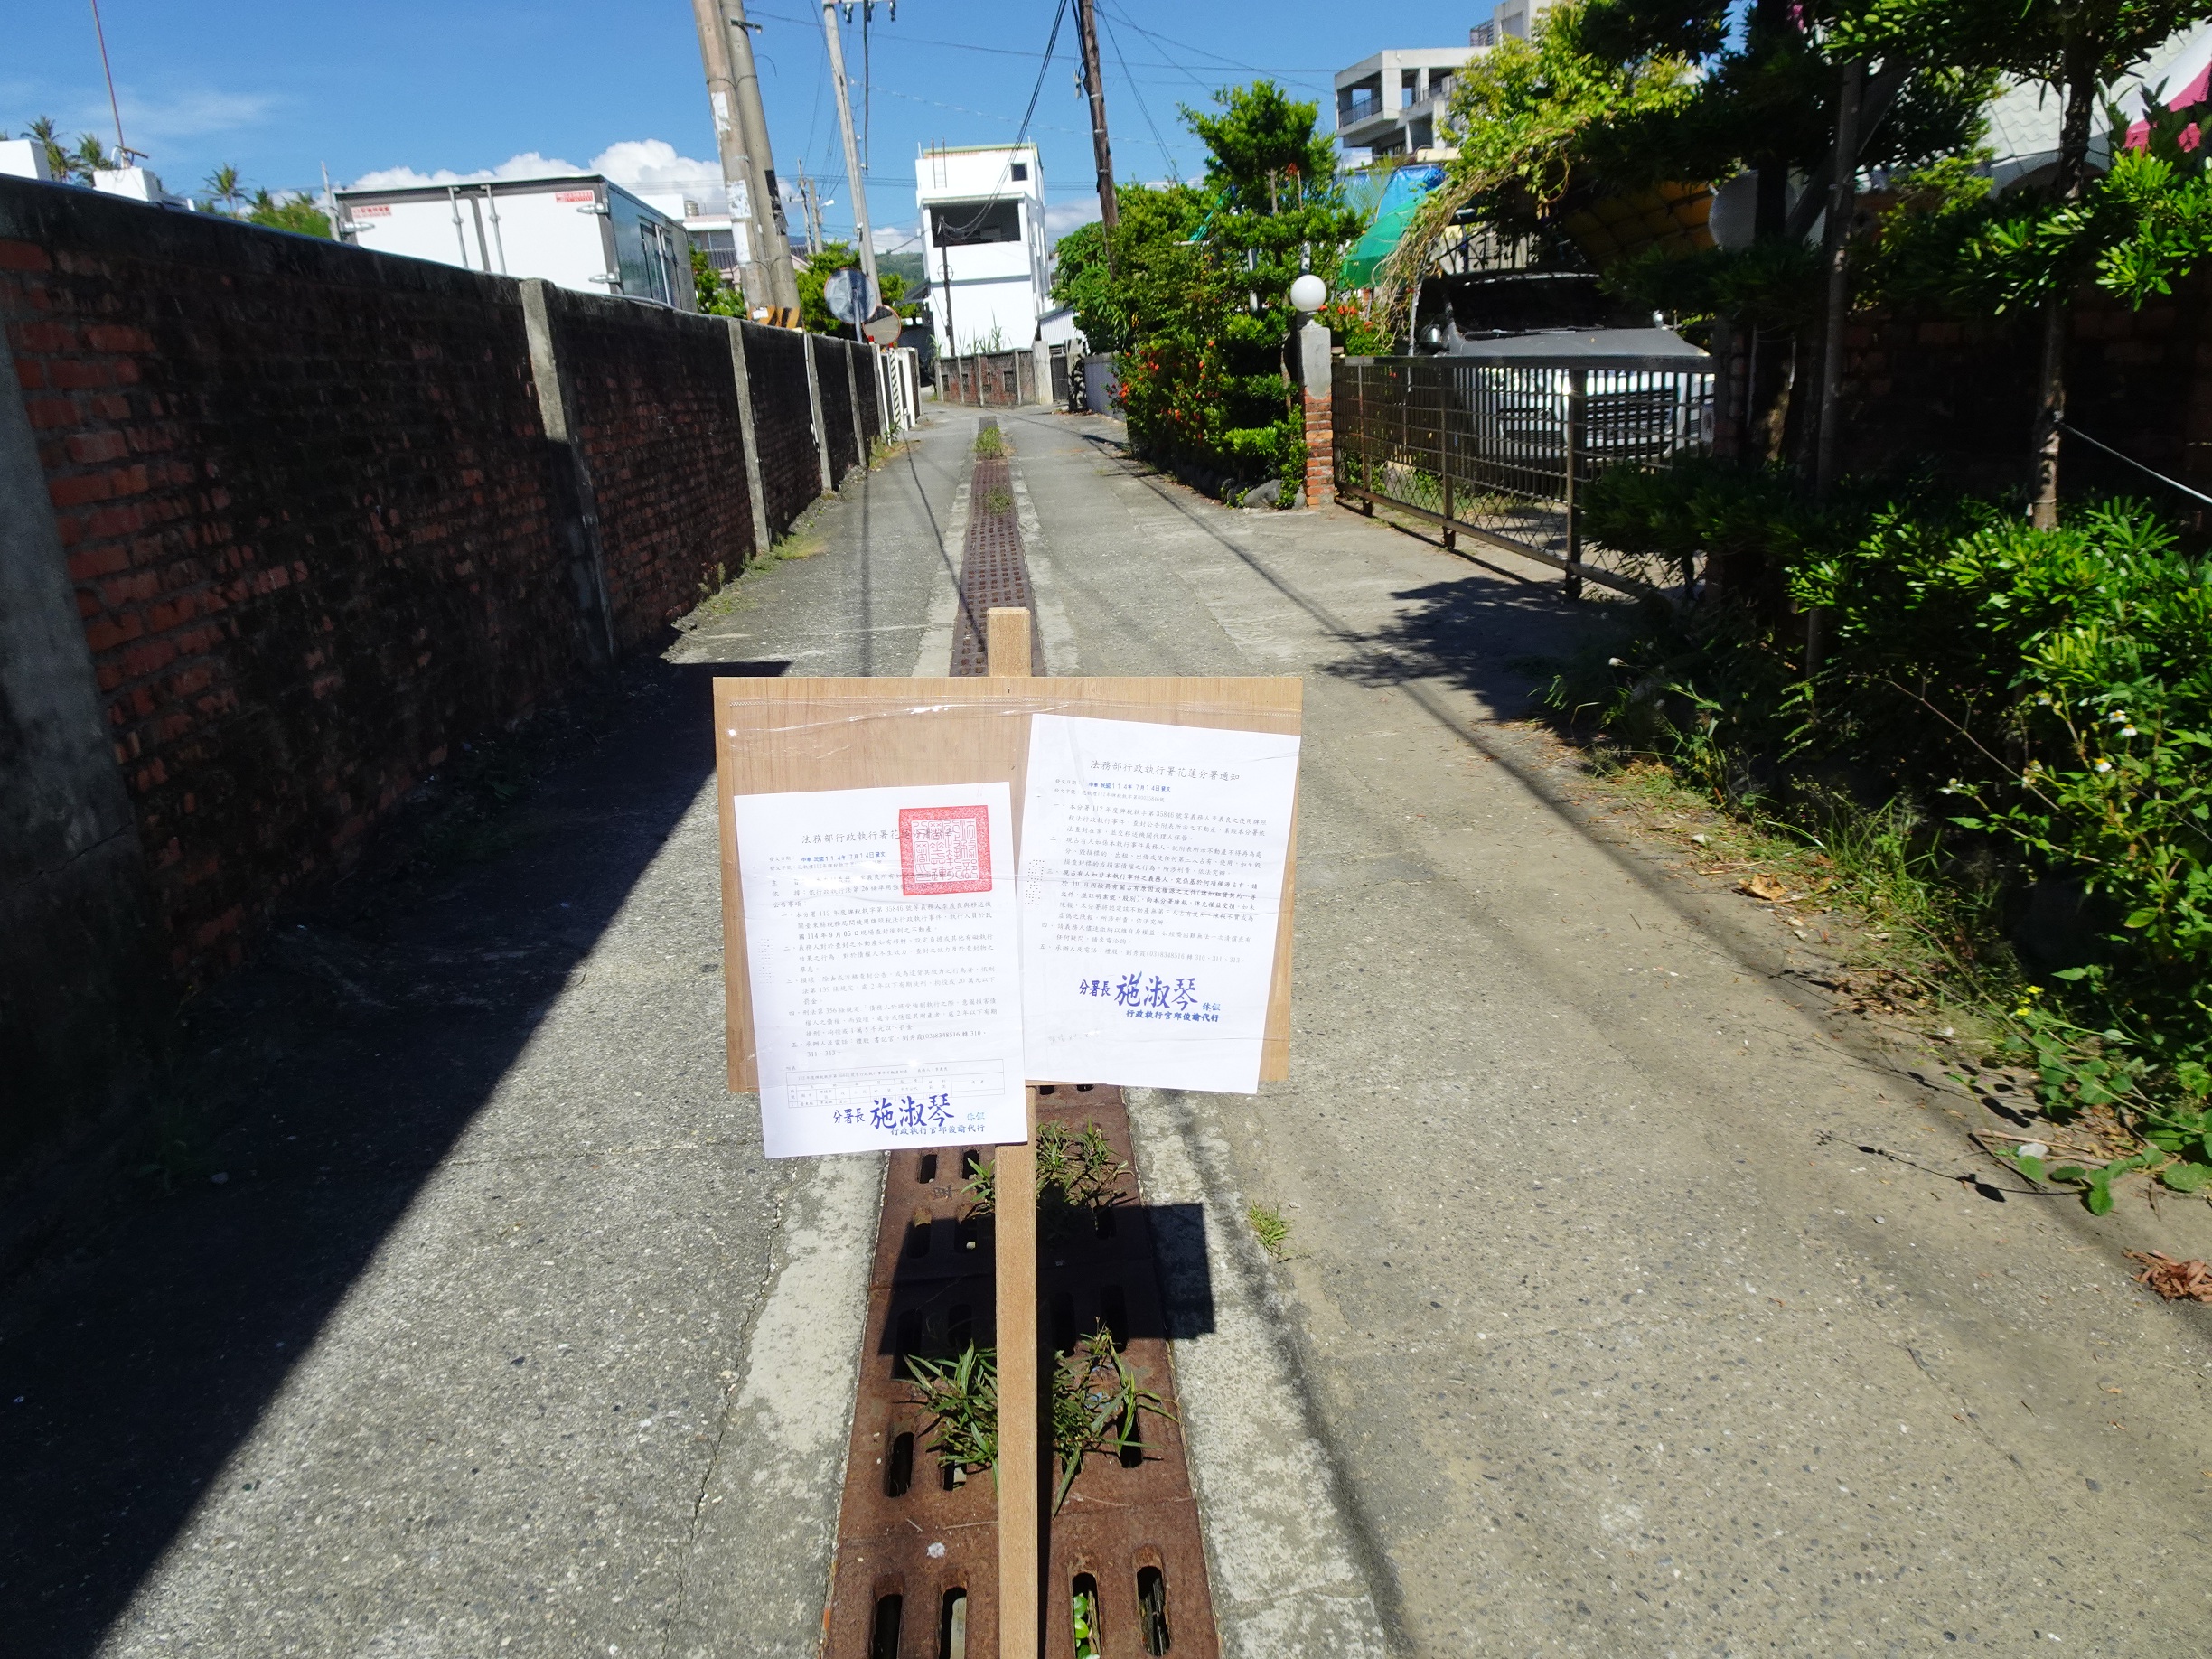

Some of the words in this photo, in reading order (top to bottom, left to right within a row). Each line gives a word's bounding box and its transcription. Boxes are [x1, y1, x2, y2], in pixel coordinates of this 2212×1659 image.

[1090, 759, 1239, 783] 法務部行政執行署花蓮分署通知
[1079, 979, 1111, 997] 分署長
[1113, 970, 1198, 1011] 施淑琴
[833, 1108, 865, 1124] 分署長
[869, 1093, 955, 1130] 施淑琴
